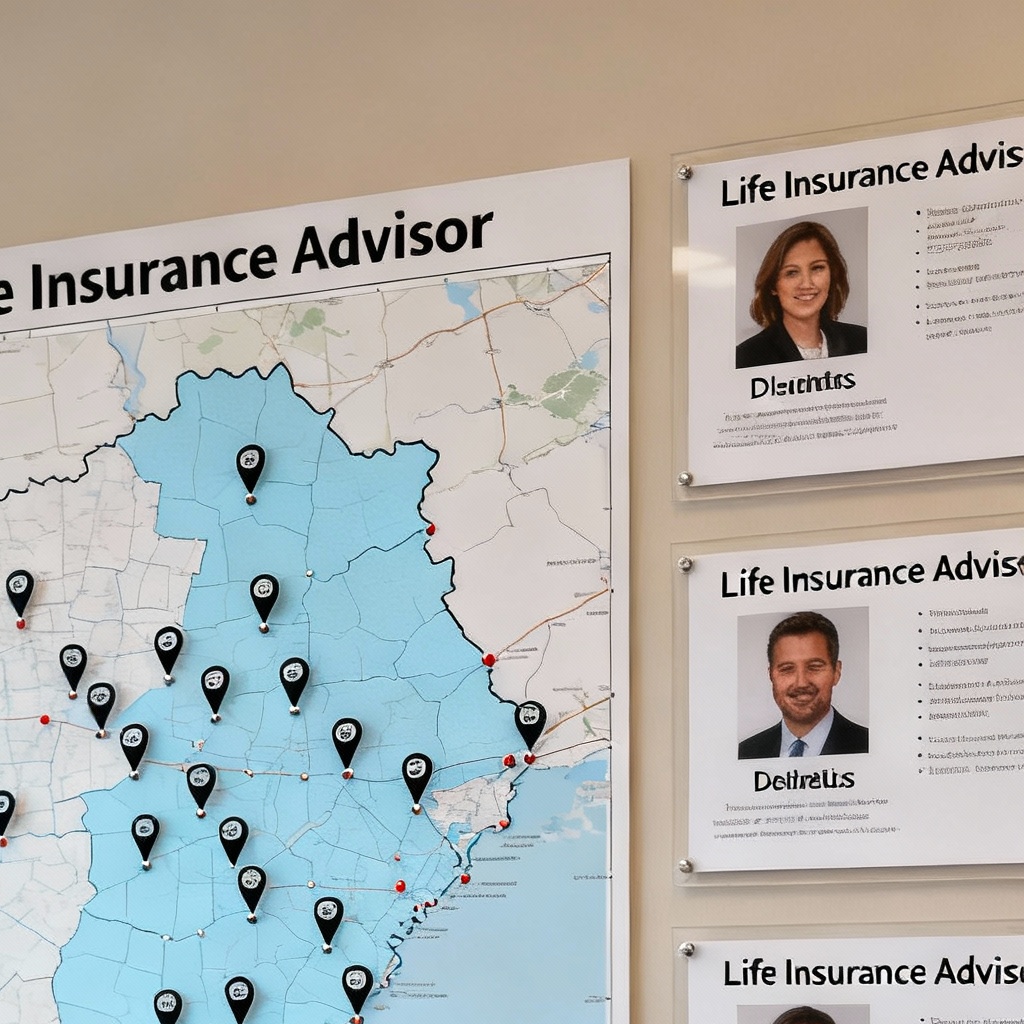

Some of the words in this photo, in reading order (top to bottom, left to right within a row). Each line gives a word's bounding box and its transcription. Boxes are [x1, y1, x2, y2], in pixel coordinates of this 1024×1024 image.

[722, 174, 776, 207] Life
[785, 159, 928, 198] Insurance
[32, 243, 278, 311] Insurance
[292, 210, 495, 275] Advisor
[721, 567, 774, 598] Life
[784, 563, 925, 593] Insurance
[724, 958, 776, 986] Life
[786, 959, 926, 986] Insurance
